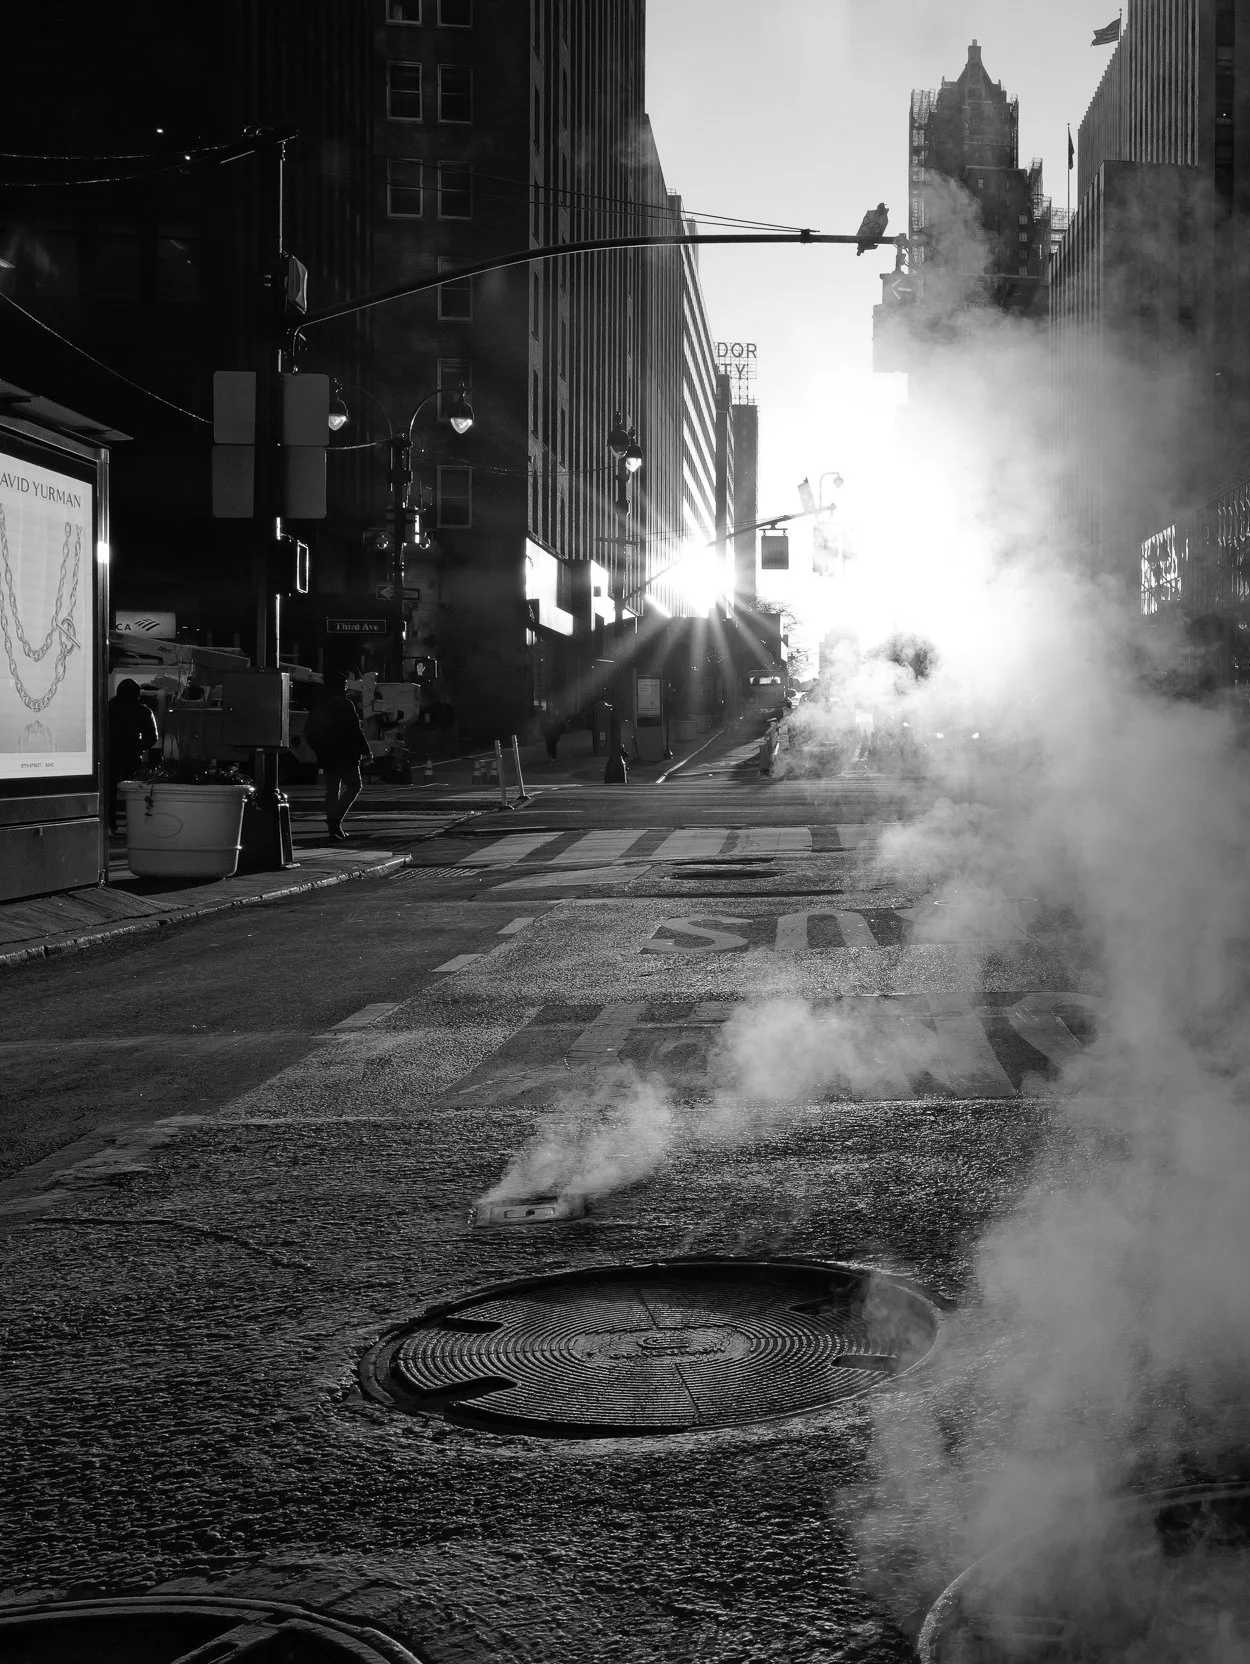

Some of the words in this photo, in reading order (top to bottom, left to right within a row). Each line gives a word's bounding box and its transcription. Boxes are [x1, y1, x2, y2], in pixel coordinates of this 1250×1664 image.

[33, 481, 81, 508] YURMAN
[335, 622, 360, 631] Third
[362, 622, 380, 631] Ave
